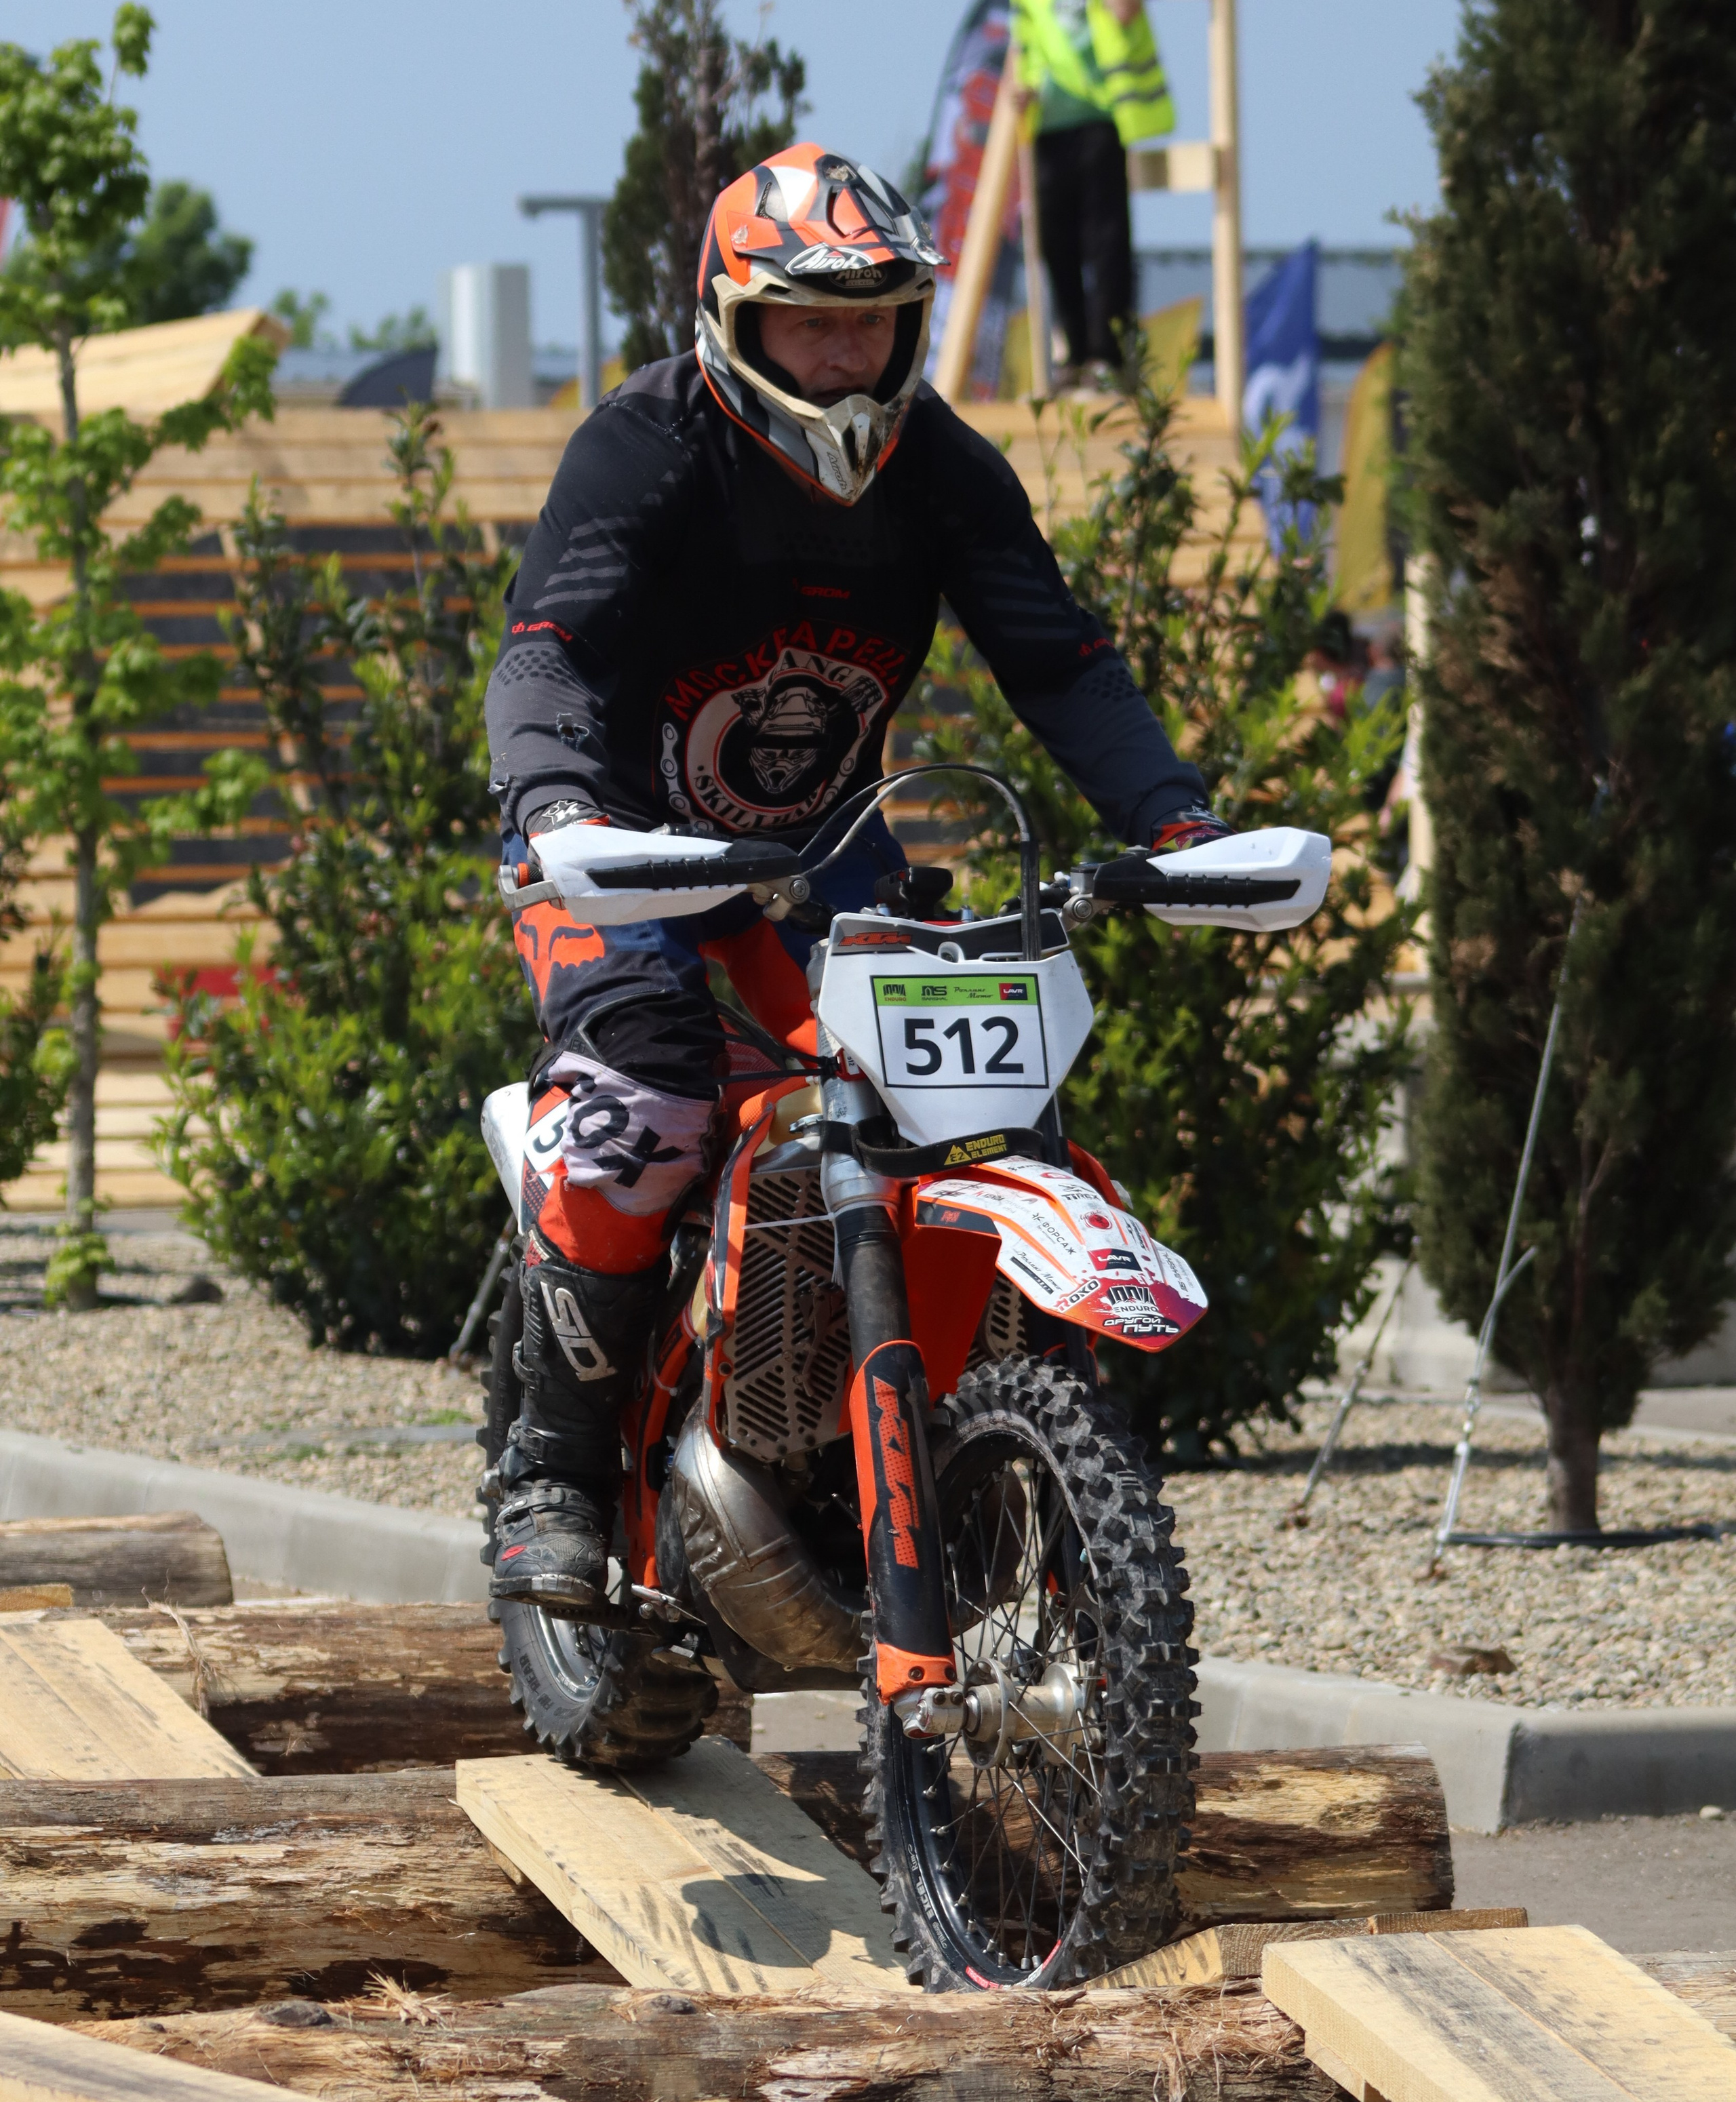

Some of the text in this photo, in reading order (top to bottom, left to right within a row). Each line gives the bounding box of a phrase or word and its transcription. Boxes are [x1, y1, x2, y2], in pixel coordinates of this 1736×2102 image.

[793, 248, 860, 270] Airoh
[837, 931, 911, 947] KTM
[903, 1016, 1025, 1076] 512
[965, 1134, 1005, 1151] ENDURO
[970, 1143, 1007, 1159] ELEMENT
[1061, 1193, 1101, 1201] TIREX
[1042, 1222, 1077, 1255] ФОРСАЖ
[1104, 1315, 1162, 1326] ДРУГОЙ
[1122, 1324, 1180, 1334] ПУТЬ
[916, 1875, 935, 1921] EXCEL
